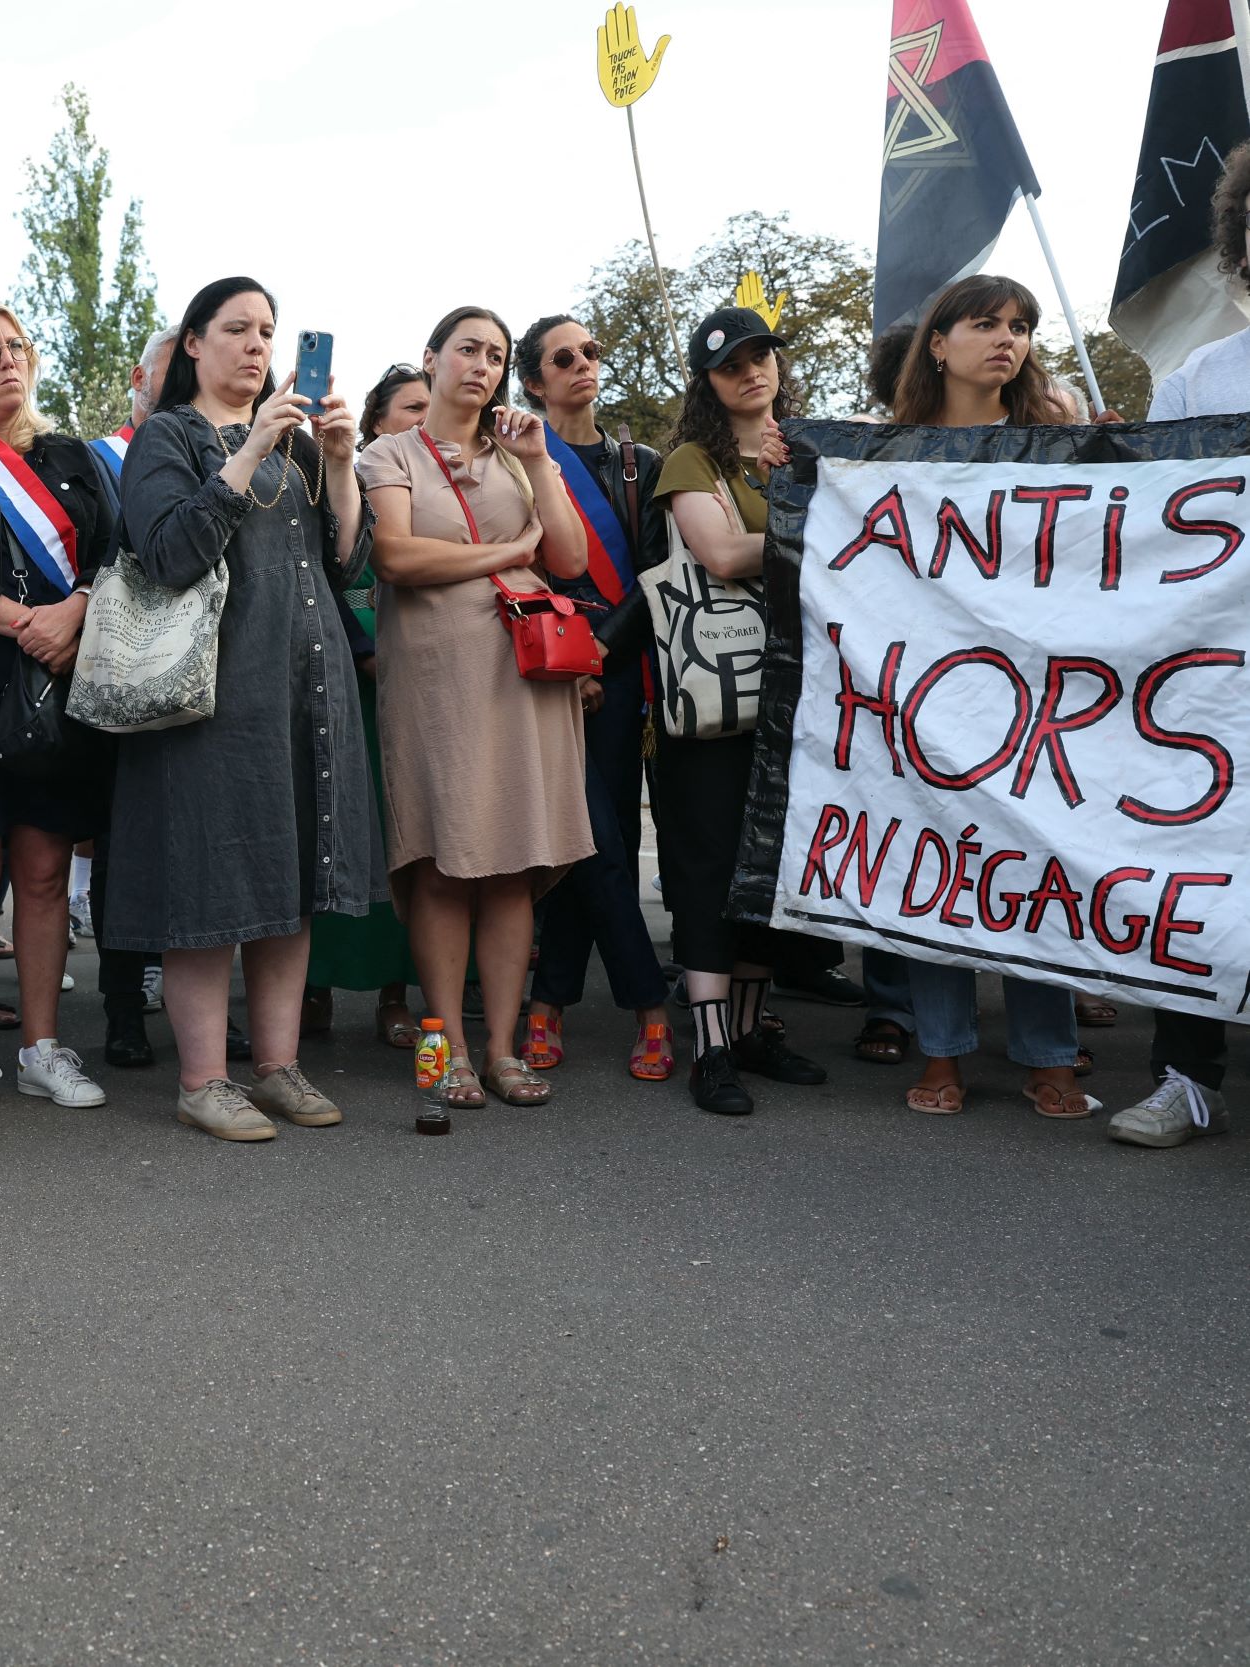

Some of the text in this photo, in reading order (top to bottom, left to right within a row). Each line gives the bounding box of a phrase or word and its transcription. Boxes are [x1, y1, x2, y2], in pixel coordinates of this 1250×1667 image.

[608, 45, 637, 66] TOUCHE
[611, 61, 626, 77] PAS
[612, 65, 639, 89] A MON
[614, 82, 637, 101] POTE
[700, 626, 760, 640] NEW YORKER
[827, 622, 1246, 826] HORS
[799, 804, 1232, 977] RN DÉGAGE
